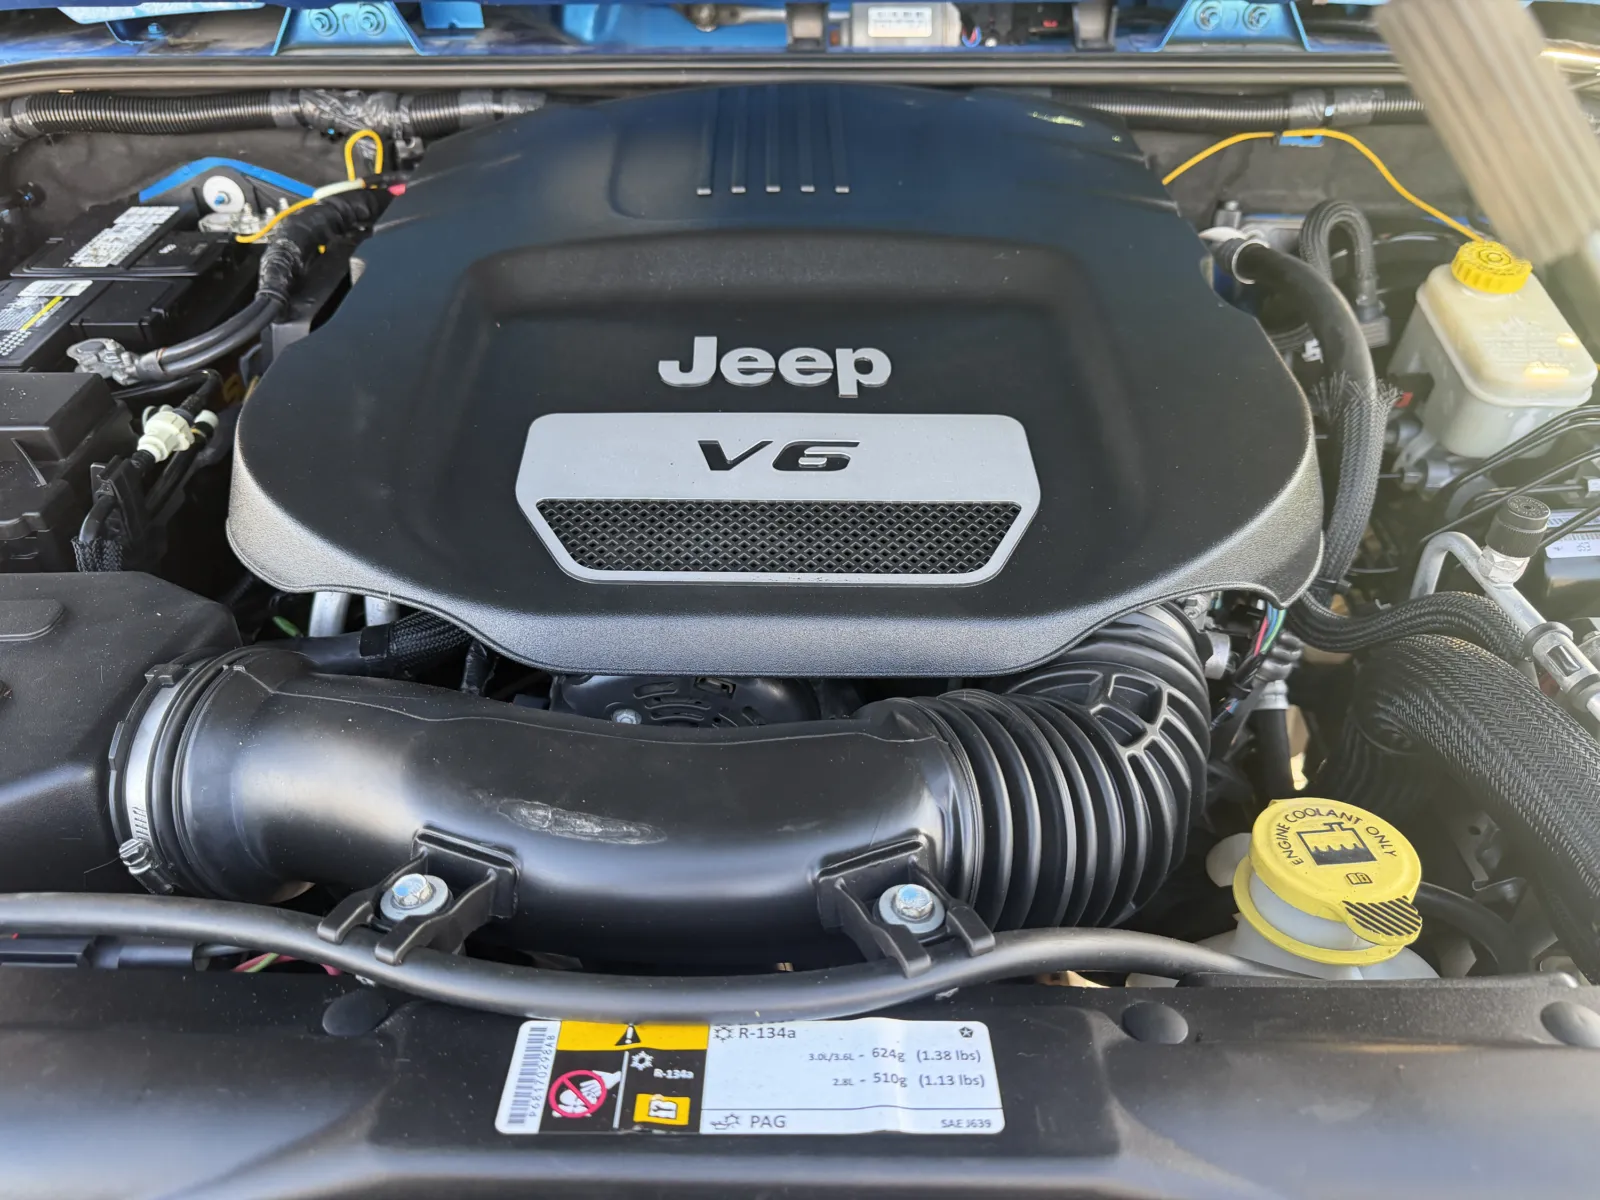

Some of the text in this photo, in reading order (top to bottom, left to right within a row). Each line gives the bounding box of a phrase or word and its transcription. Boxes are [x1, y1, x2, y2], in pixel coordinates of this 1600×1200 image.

[658, 336, 892, 398] Jeep
[697, 440, 860, 471] V6
[1274, 807, 1397, 867] ENGINE COOLANT ONLY
[738, 1027, 796, 1039] R-134a
[808, 1052, 855, 1062] 3.0L/3.6L
[872, 1047, 905, 1062] 624g
[916, 1049, 952, 1063] (1.38
[956, 1049, 981, 1063] lbs)
[653, 1068, 694, 1079] R-134a
[833, 1078, 854, 1086] 2.8L
[873, 1072, 908, 1087] 510g
[919, 1074, 955, 1088] (1.13
[959, 1074, 986, 1088] lbs)
[750, 1115, 786, 1128] PAG
[941, 1119, 965, 1128] SAE
